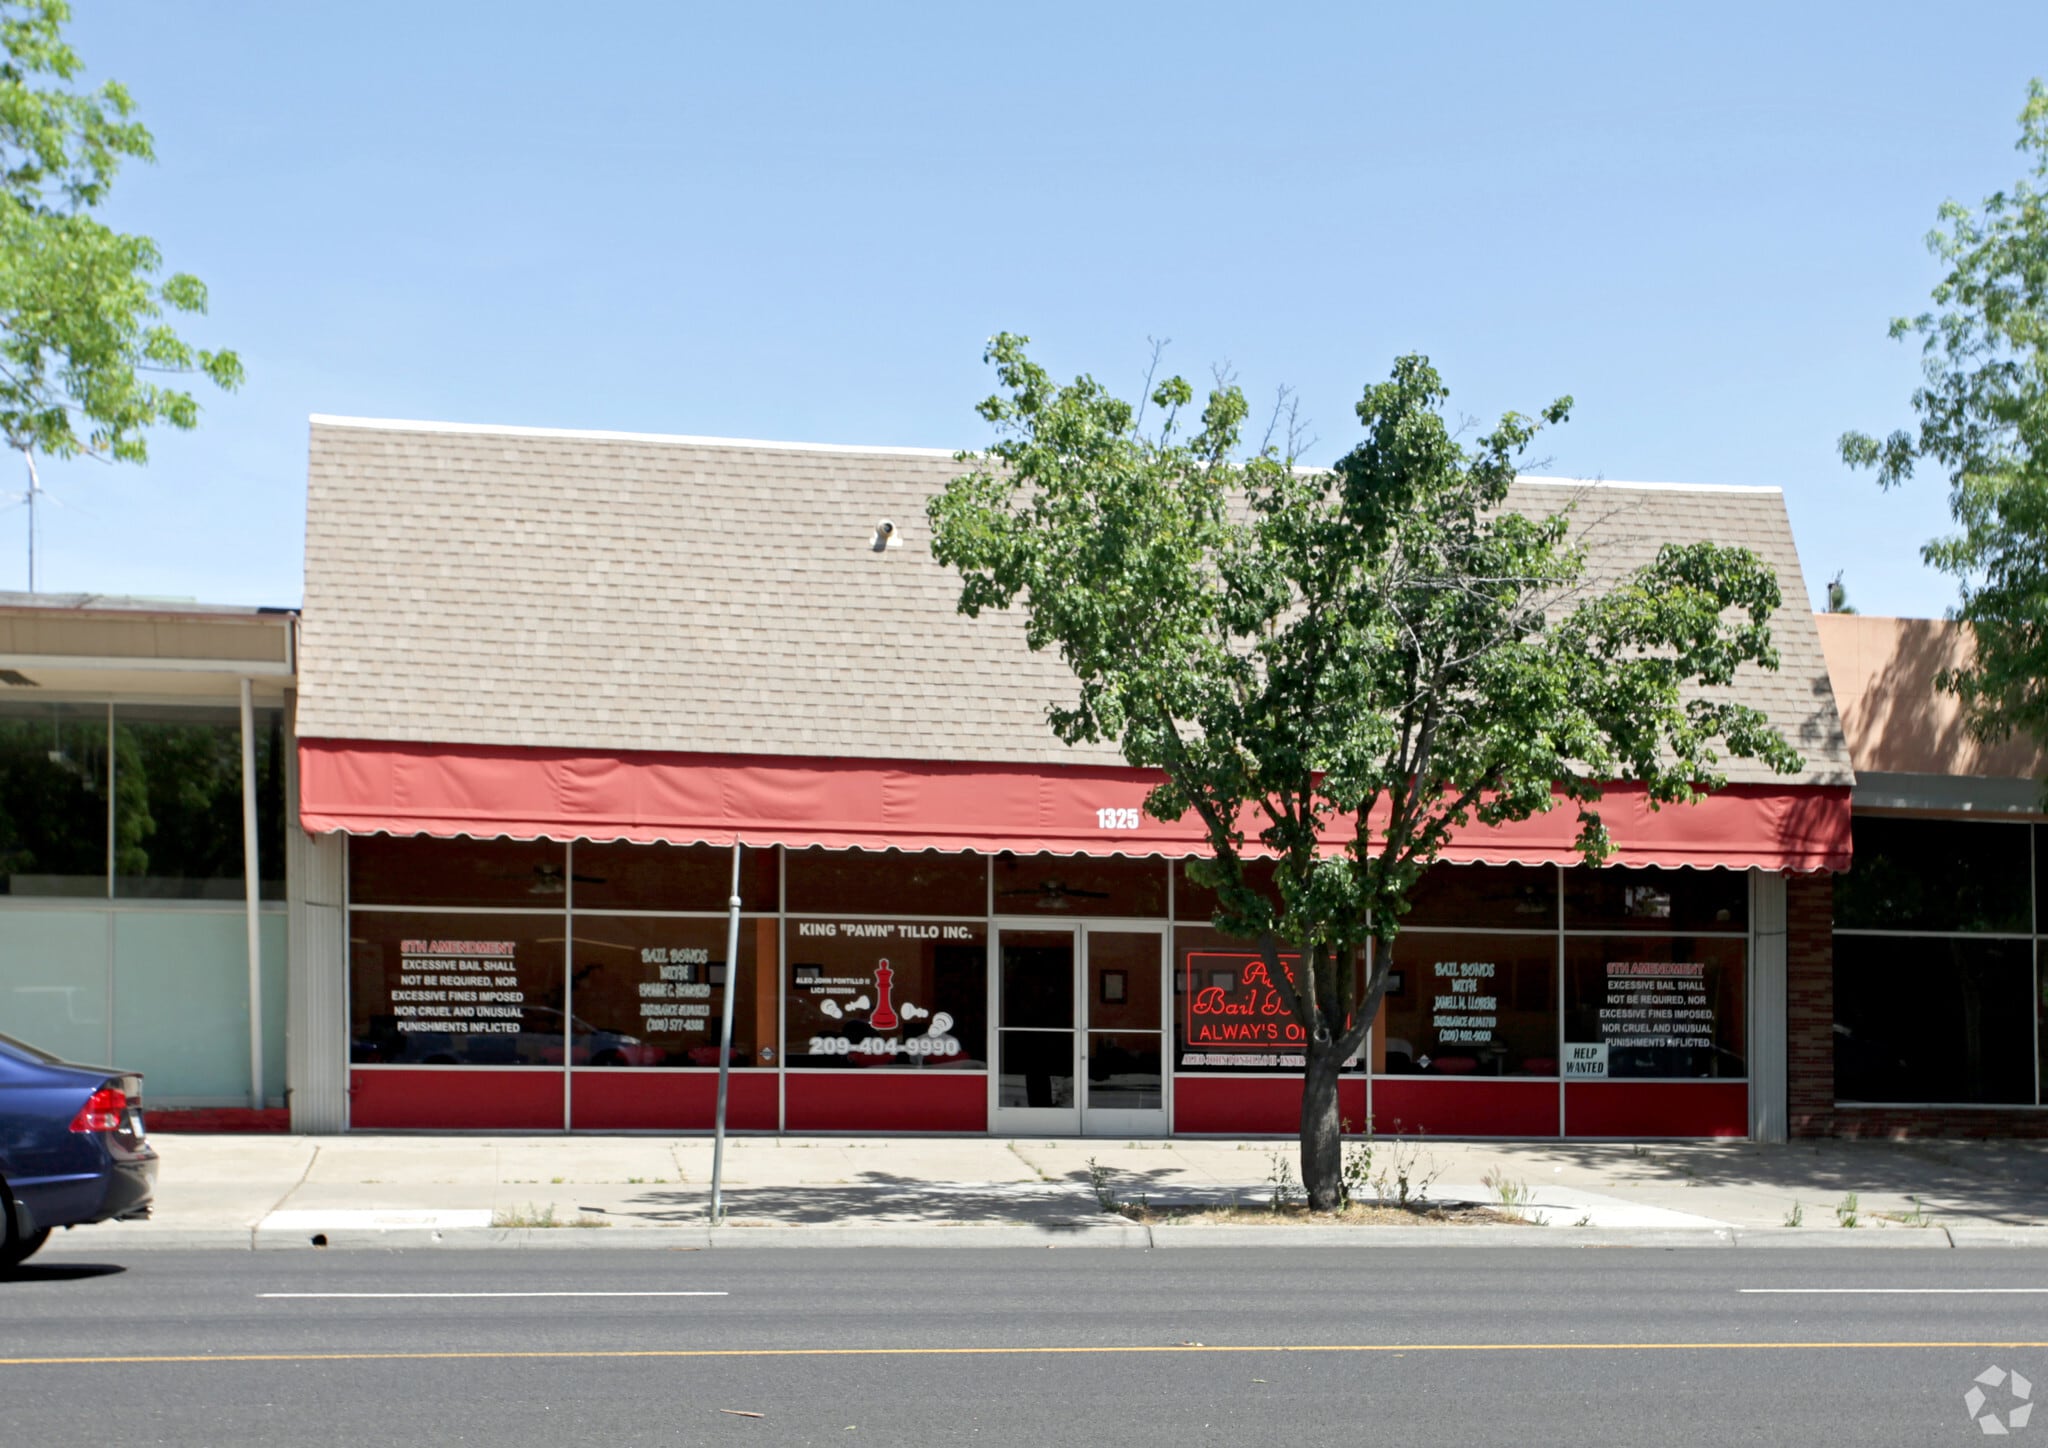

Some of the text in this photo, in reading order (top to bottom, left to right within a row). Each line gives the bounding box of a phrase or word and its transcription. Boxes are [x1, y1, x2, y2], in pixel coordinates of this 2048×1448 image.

[1096, 807, 1139, 829] 1325
[799, 923, 973, 939] KING "PAWN" TILLO INC.
[401, 940, 516, 954] 8TH AMENDMENT
[641, 947, 708, 964] BAIL BONDS
[402, 959, 516, 971] EXCESSIVE BAIL SHALL
[1434, 962, 1495, 977] BAIL BONDS
[1630, 962, 1704, 975] AMENDMENT
[401, 975, 517, 987] NOT BE REQUIRED, NOR
[1608, 980, 1705, 991] EXCESSIVE BAIL SHALL
[391, 990, 446, 1001] EXCESSIVE
[448, 991, 477, 1001] FINES
[1193, 986, 1257, 1016] Bail
[1607, 995, 1707, 1005] NOT BE REQUIRED, NOR
[394, 1006, 524, 1018] NOR CRUEL AND UNUSUAL
[1600, 1009, 1715, 1020] EXCESSIVE FINES IMPOSED,
[397, 1021, 520, 1033] PUNISHMENTS INFLICTED
[1199, 1023, 1279, 1041] ALWAY'S
[1602, 1023, 1713, 1034] NOR CRUEL AND UNUSUAL
[808, 1036, 960, 1056] 209-404-9990
[1605, 1038, 1710, 1048] PUNISHMENTS INFLICTED
[1573, 1047, 1598, 1060] HELP
[1566, 1061, 1604, 1074] WANTED
